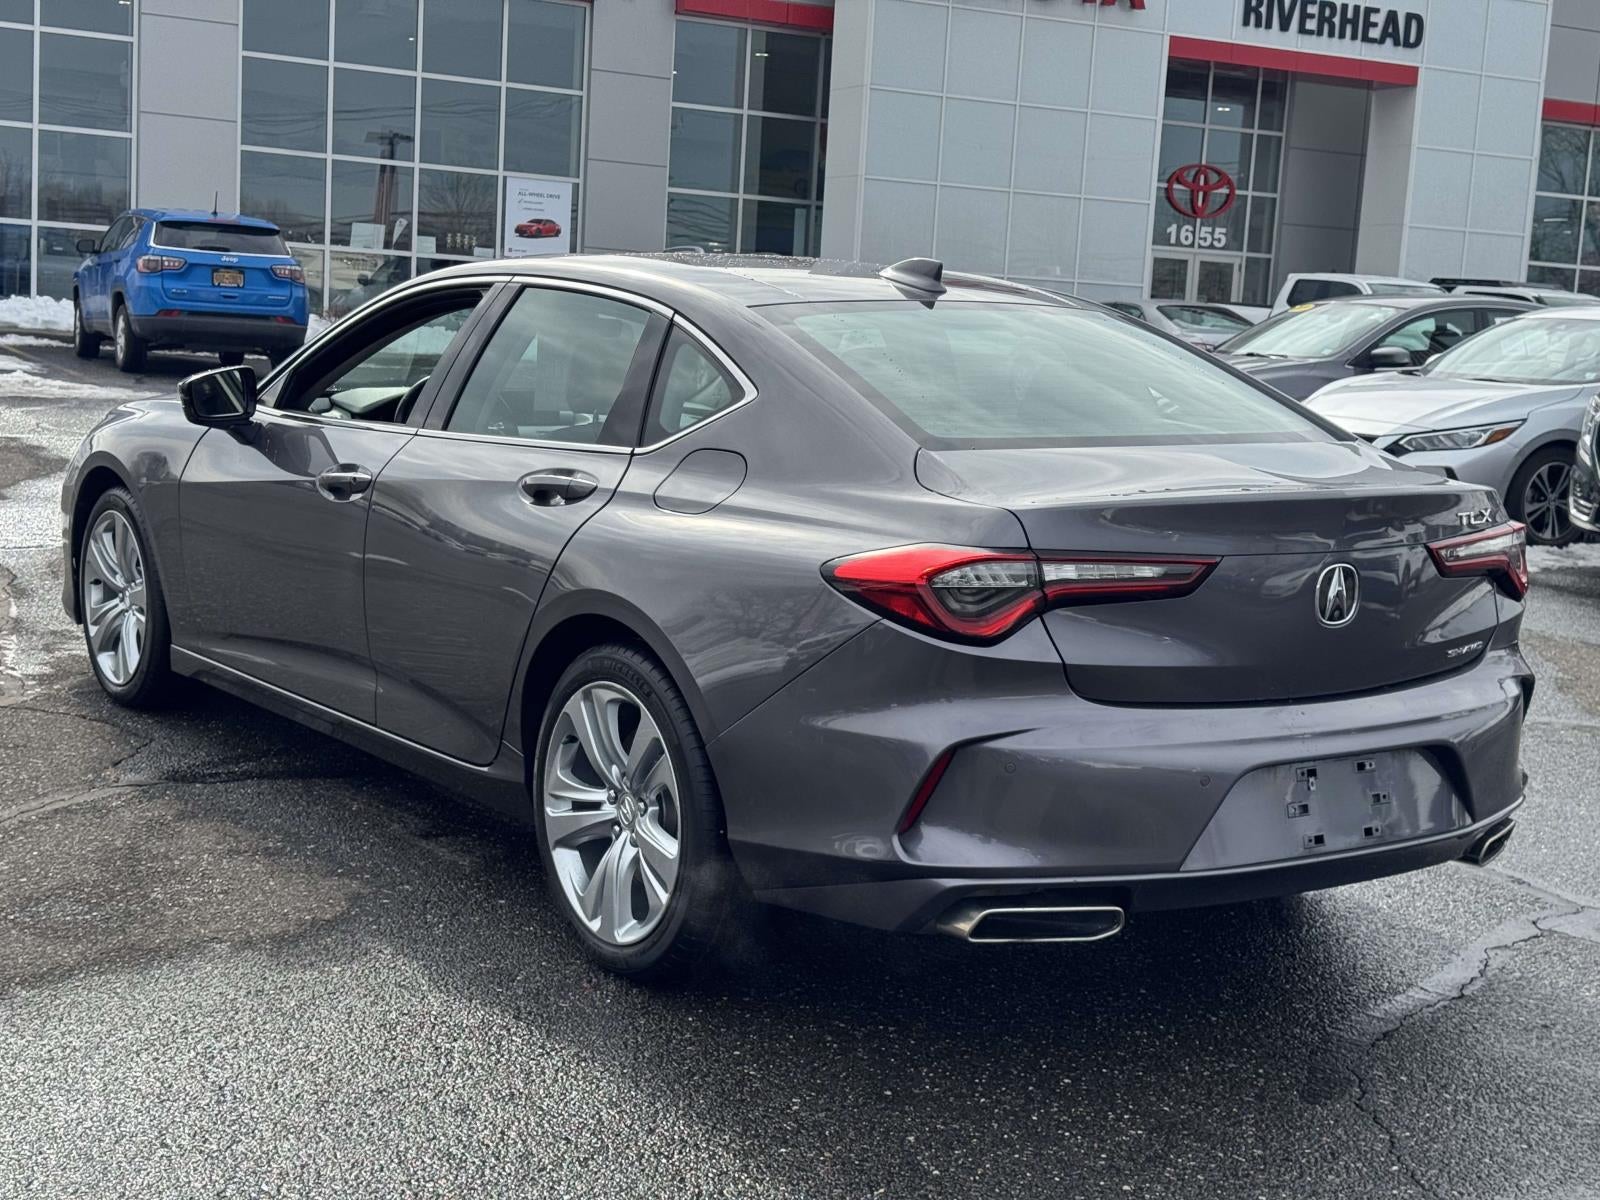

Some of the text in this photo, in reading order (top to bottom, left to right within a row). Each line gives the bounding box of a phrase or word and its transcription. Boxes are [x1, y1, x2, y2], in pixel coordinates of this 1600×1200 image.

[1242, 0, 1424, 49] RIVERHEAD
[517, 191, 545, 199] ALL-WHEEL
[1166, 223, 1227, 248] 1655
[221, 255, 239, 263] Jeep
[1457, 508, 1492, 526] TLX
